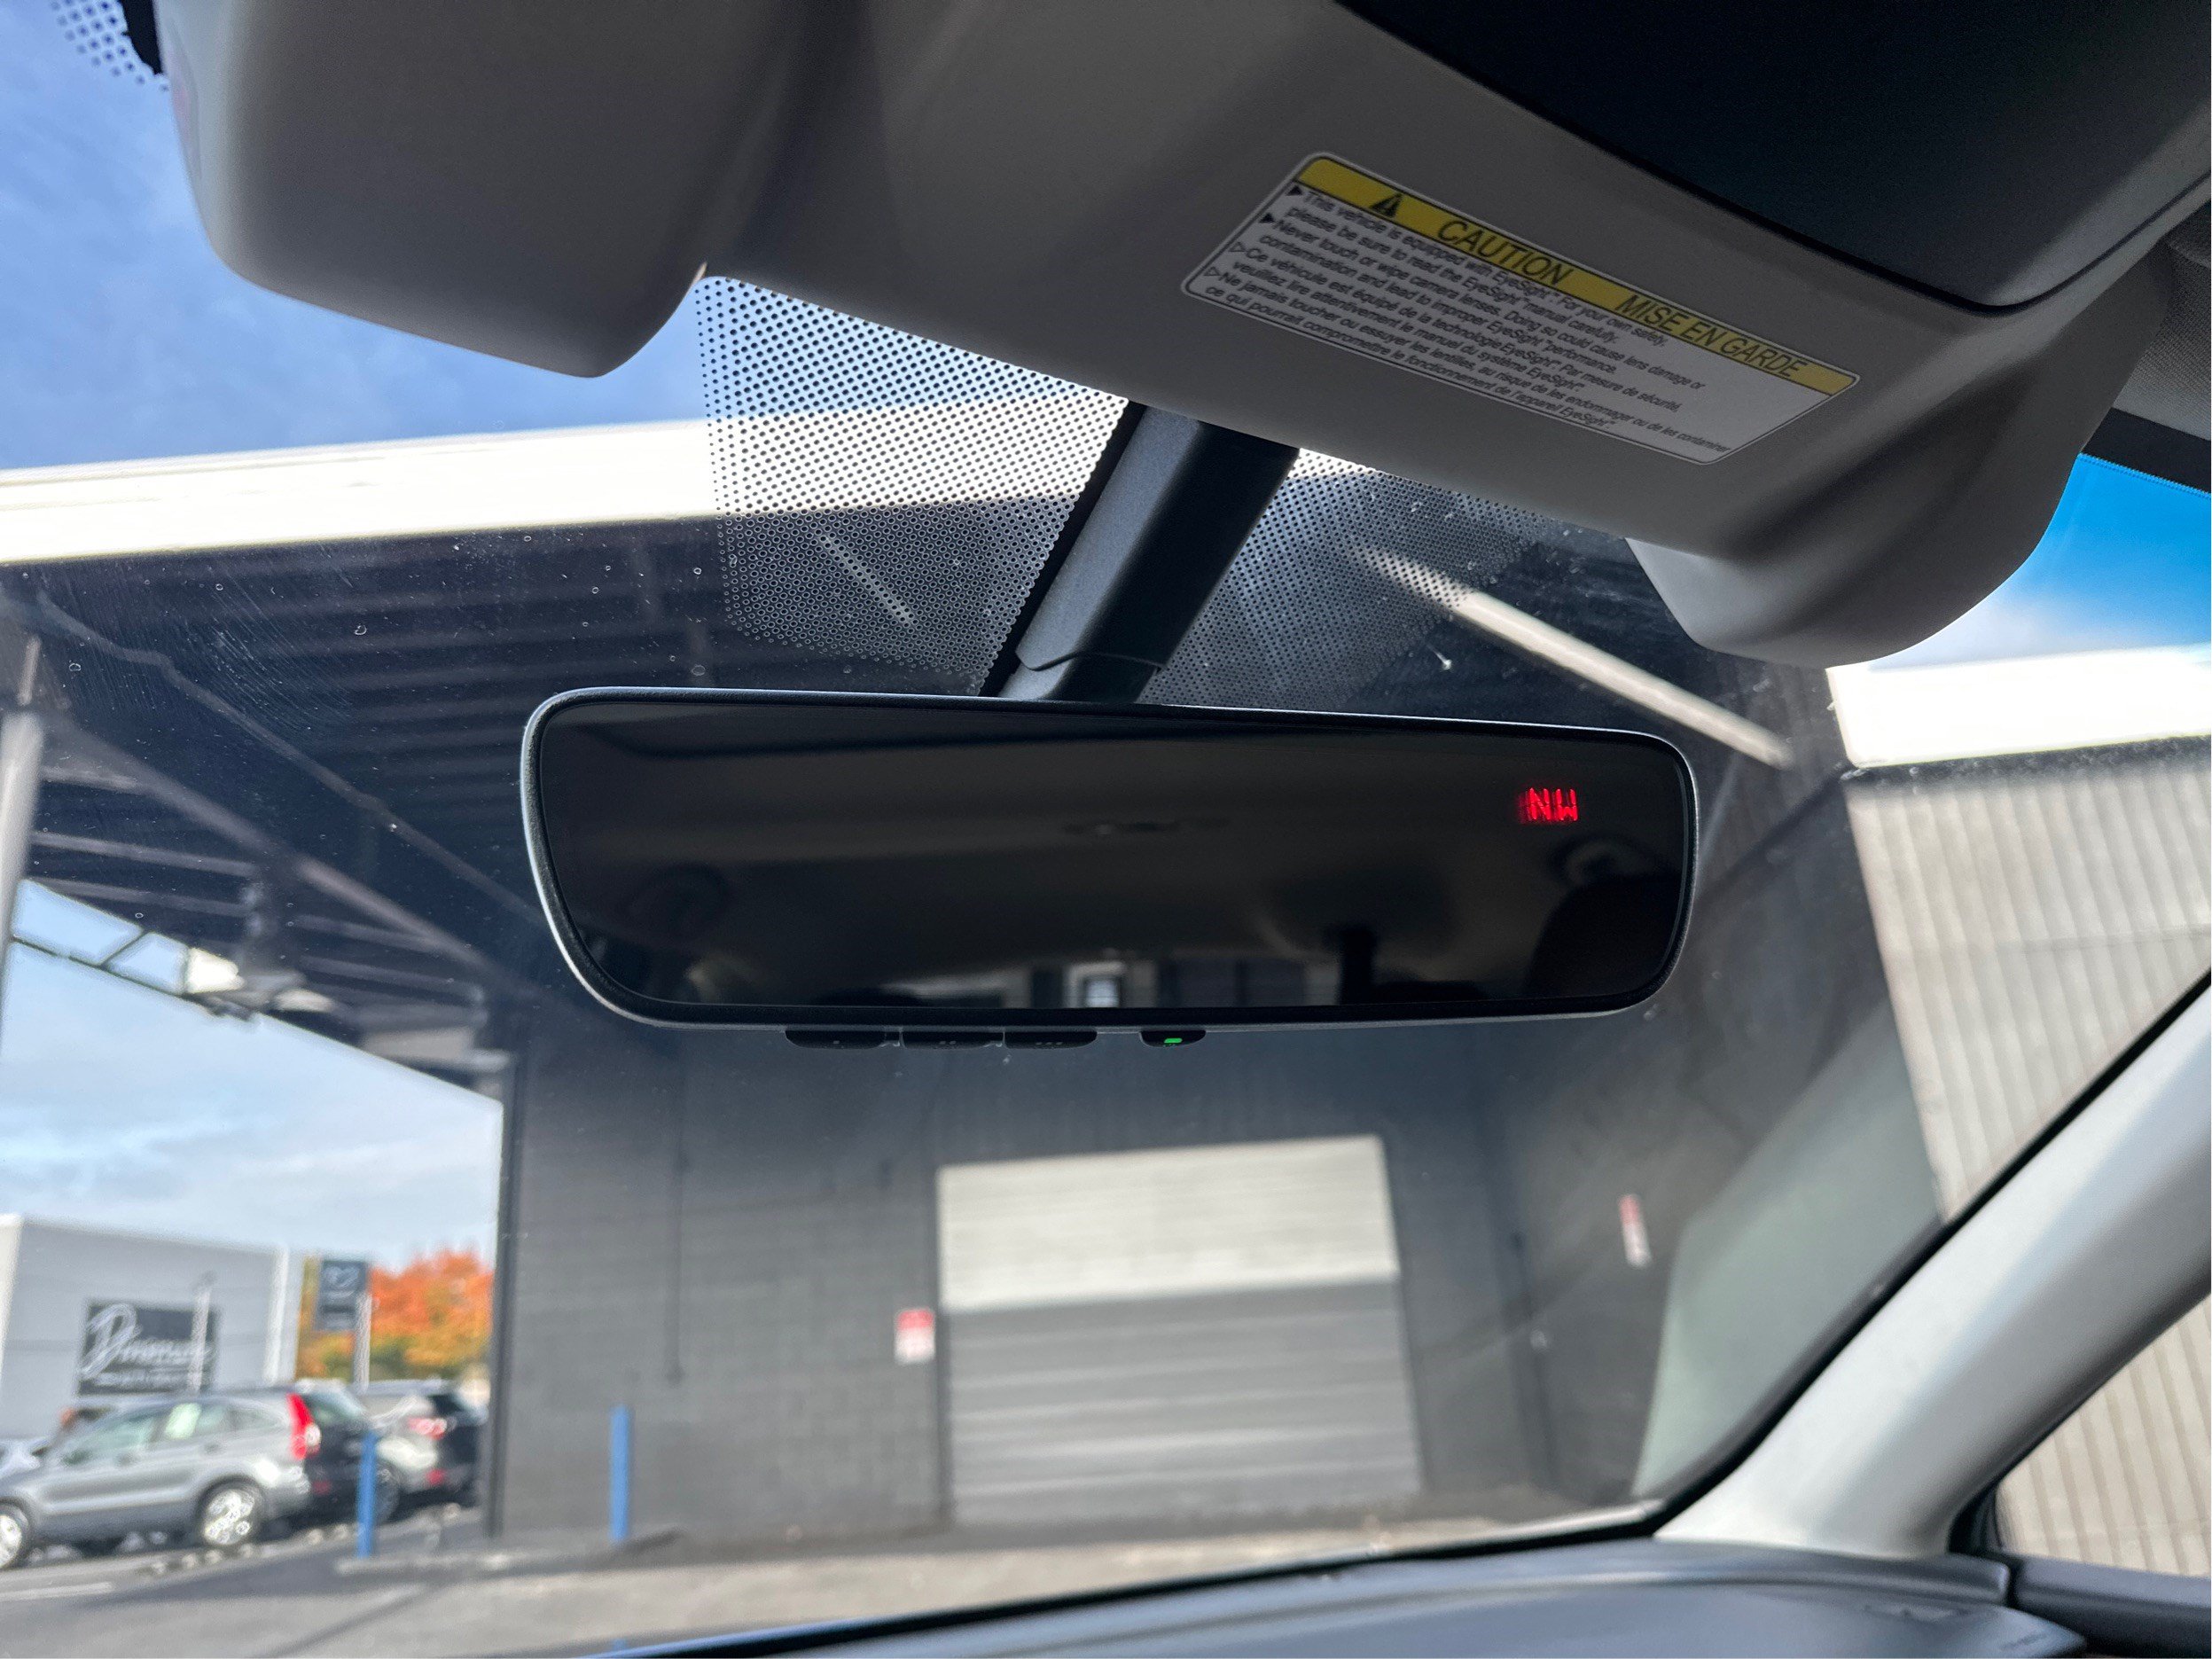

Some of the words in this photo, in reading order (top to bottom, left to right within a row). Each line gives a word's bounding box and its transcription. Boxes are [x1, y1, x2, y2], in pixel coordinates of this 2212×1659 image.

[1258, 234, 1358, 278] contamination
[1356, 272, 1388, 289] and
[1384, 281, 1420, 301] lead
[1414, 293, 1432, 306] to
[1429, 298, 1489, 326] improper
[1271, 218, 1320, 243] Never
[1317, 237, 1360, 261] touch
[1357, 255, 1378, 267] or
[1376, 262, 1411, 280] wipe
[1408, 275, 1460, 300] camera
[1502, 309, 1543, 333] Doing
[1539, 325, 1559, 337] so
[1556, 331, 1594, 348] could
[1588, 343, 1625, 361] cause
[1622, 355, 1650, 371] lens
[1646, 364, 1692, 386] damage
[1688, 380, 1706, 390] or
[1283, 206, 1338, 232] please
[1335, 224, 1358, 241] be
[1356, 236, 1392, 254] sure
[1389, 247, 1408, 261] to
[1406, 255, 1442, 274] read
[1438, 267, 1463, 283] the
[1521, 301, 1573, 324] manual
[1304, 190, 1336, 212] This
[1336, 207, 1387, 234] vehicle
[1386, 228, 1403, 240] is
[1401, 235, 1468, 266] equipped
[1464, 261, 1493, 277] with
[1556, 295, 1582, 310] For
[1574, 306, 1609, 322] your
[1606, 317, 1633, 331] own
[1437, 219, 1575, 286] CAUTION
[1204, 286, 1225, 297] ce
[1224, 293, 1253, 306] qui
[1389, 348, 1406, 360] le
[1493, 385, 1512, 395] de
[1217, 270, 1242, 286] Ne
[1237, 279, 1289, 304] jamais
[1287, 297, 1342, 322] toucher
[1339, 317, 1360, 329] ou
[1357, 324, 1412, 347] essuyer
[1408, 340, 1431, 354] les
[1477, 365, 1497, 376] au
[1493, 371, 1533, 388] risque
[1529, 383, 1549, 394] de
[1545, 387, 1567, 400] les
[1563, 395, 1636, 422] endommager
[1631, 418, 1649, 427] ou
[1645, 422, 1663, 432] de
[1659, 426, 1679, 437] les
[1675, 432, 1731, 453] contaminer
[1231, 260, 1288, 287] veuillez
[1285, 279, 1311, 295] lire
[1397, 321, 1415, 333] le
[1412, 327, 1464, 349] manuel
[1458, 344, 1480, 356] du
[1244, 247, 1270, 262] Ce
[1269, 257, 1328, 286] véhicule
[1327, 280, 1355, 294] est
[1350, 287, 1401, 311] équipé
[1396, 306, 1418, 318] de
[1416, 312, 1433, 325] la
[1430, 317, 1503, 349] technologie
[1558, 363, 1584, 377] Par
[1579, 372, 1624, 392] mesure
[1621, 386, 1639, 397] de
[1613, 293, 1690, 332] MISE
[1678, 320, 1728, 347] EN
[1718, 336, 1809, 378] GARDE
[1527, 787, 1578, 821] NW
